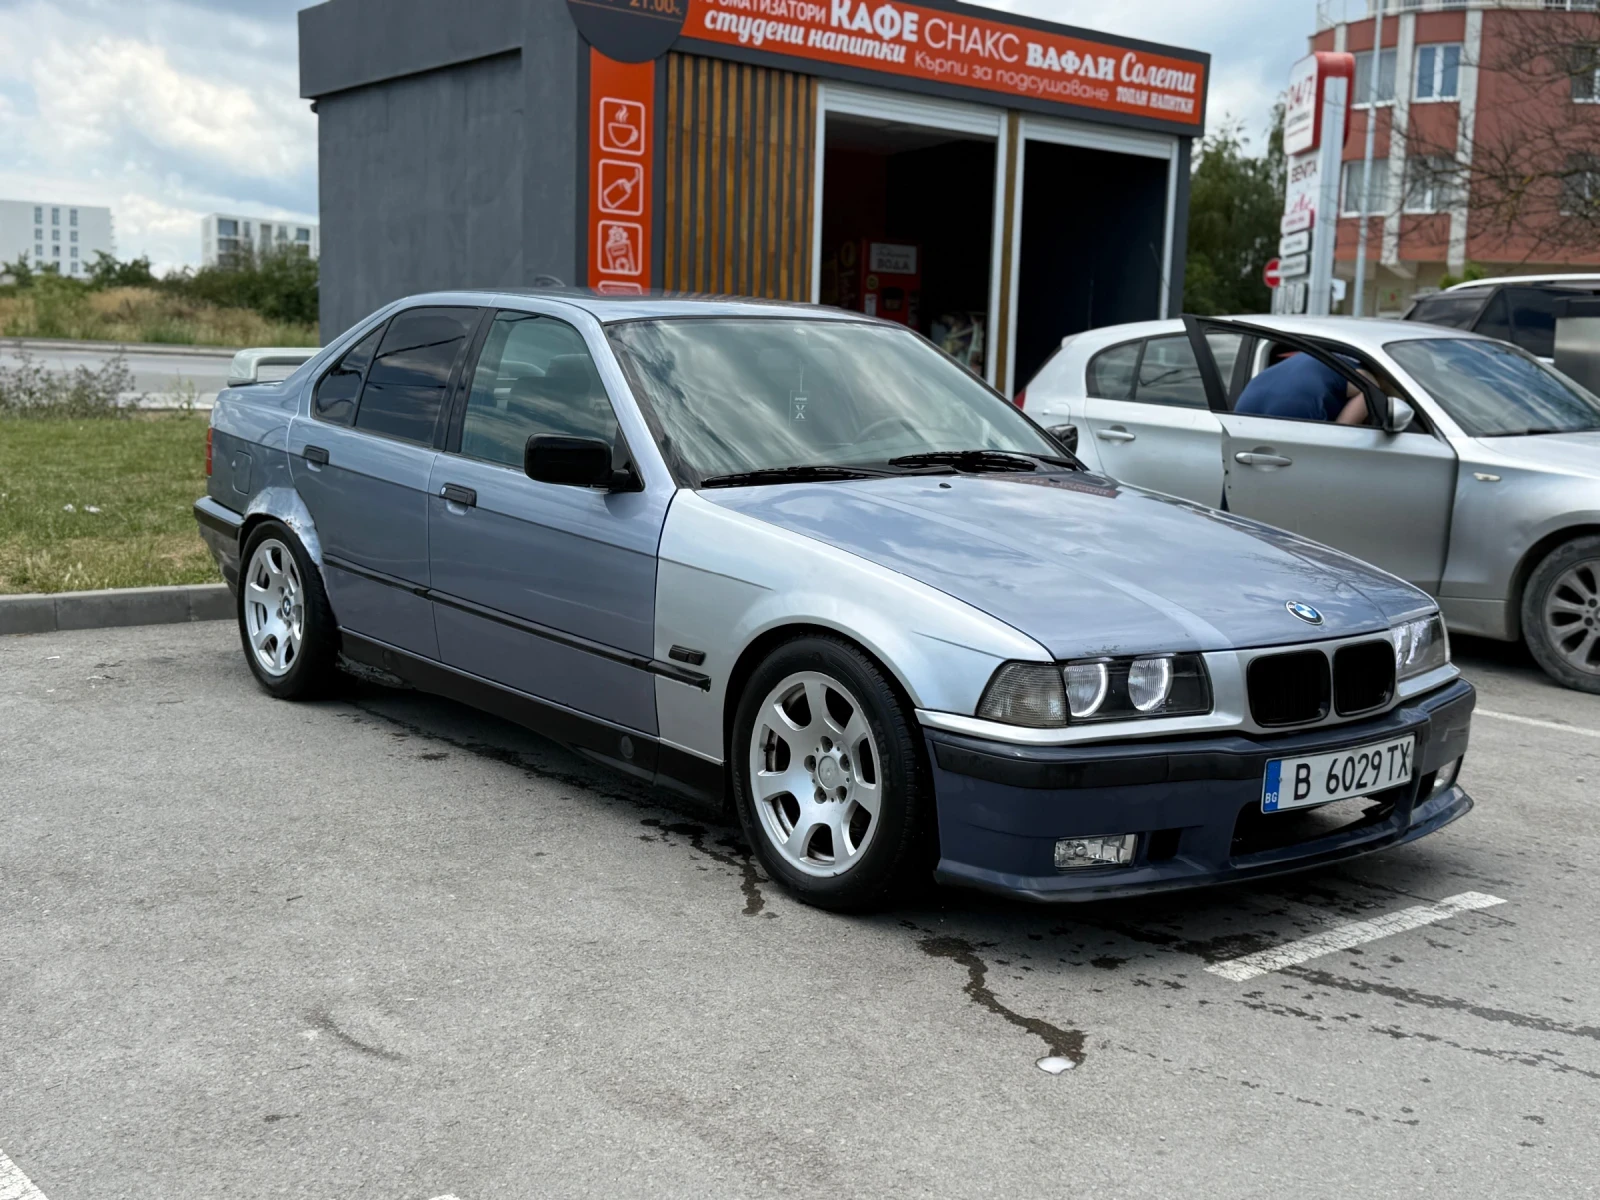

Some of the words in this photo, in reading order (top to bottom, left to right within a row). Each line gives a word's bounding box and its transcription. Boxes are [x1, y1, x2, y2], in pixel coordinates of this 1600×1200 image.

[704, 9, 805, 46] студени
[807, 28, 907, 63] напитки
[914, 50, 969, 77] Кърпи
[971, 64, 993, 81] за
[995, 69, 1110, 102] подсушаване
[830, 0, 919, 43] КАФЕ
[924, 17, 1020, 63] СНАКС
[1025, 42, 1116, 81] ВАФЛИ
[1120, 51, 1197, 93] Солети
[1265, 793, 1278, 804] BG
[1294, 764, 1311, 801] B
[1325, 750, 1382, 794] 6029
[1387, 741, 1411, 781] TX
